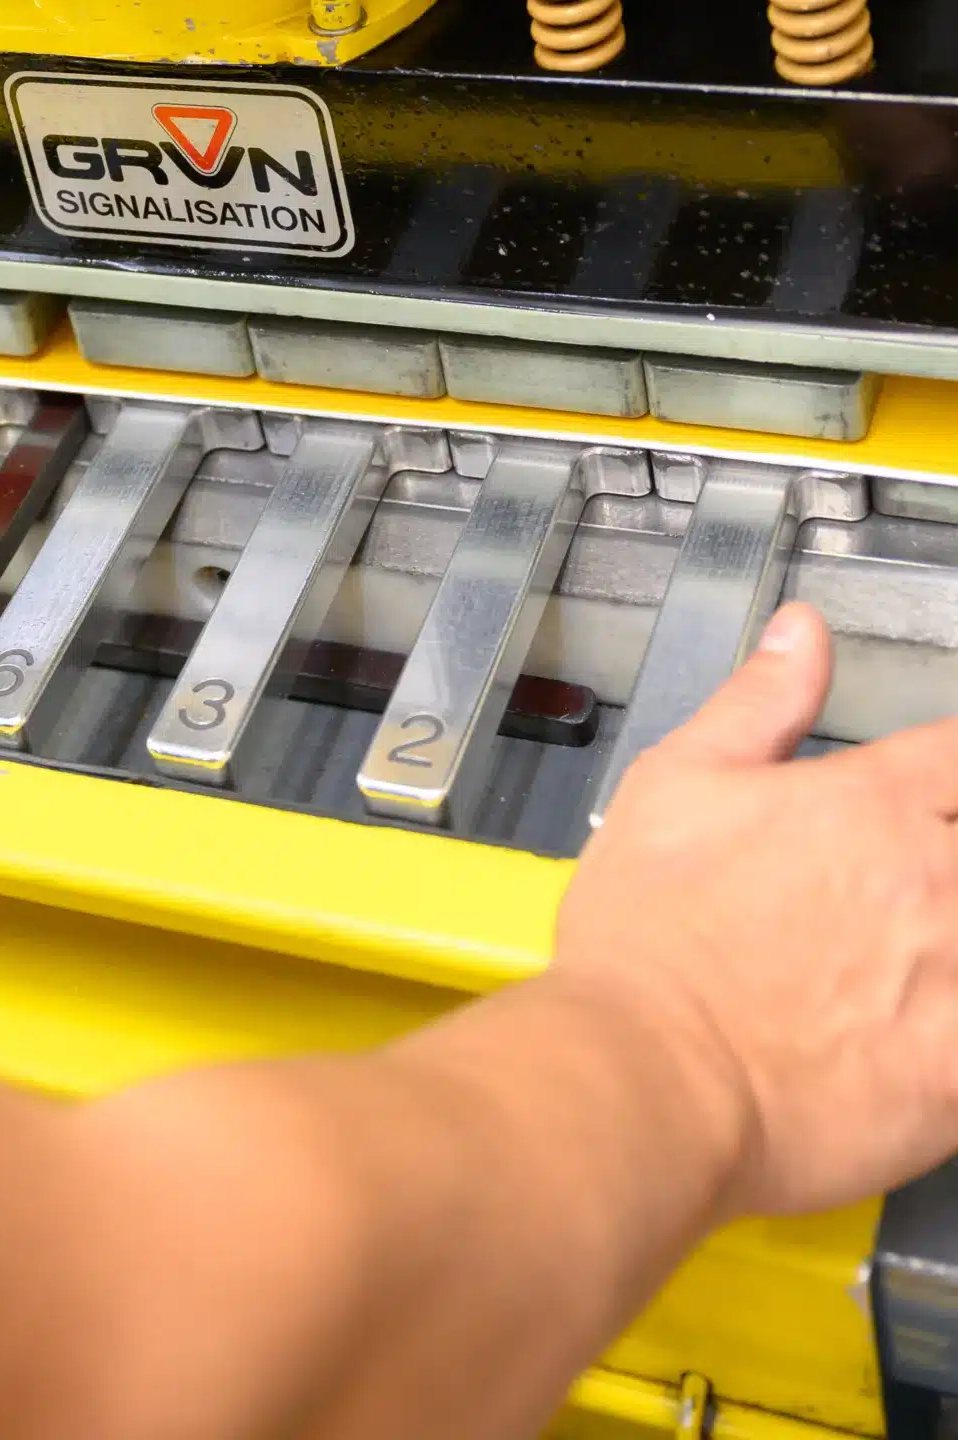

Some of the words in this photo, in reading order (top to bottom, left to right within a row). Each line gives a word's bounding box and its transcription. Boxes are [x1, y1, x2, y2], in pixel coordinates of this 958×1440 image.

[56, 190, 326, 235] SIGNALISATION
[178, 677, 235, 730] 3
[387, 714, 446, 768] 2
